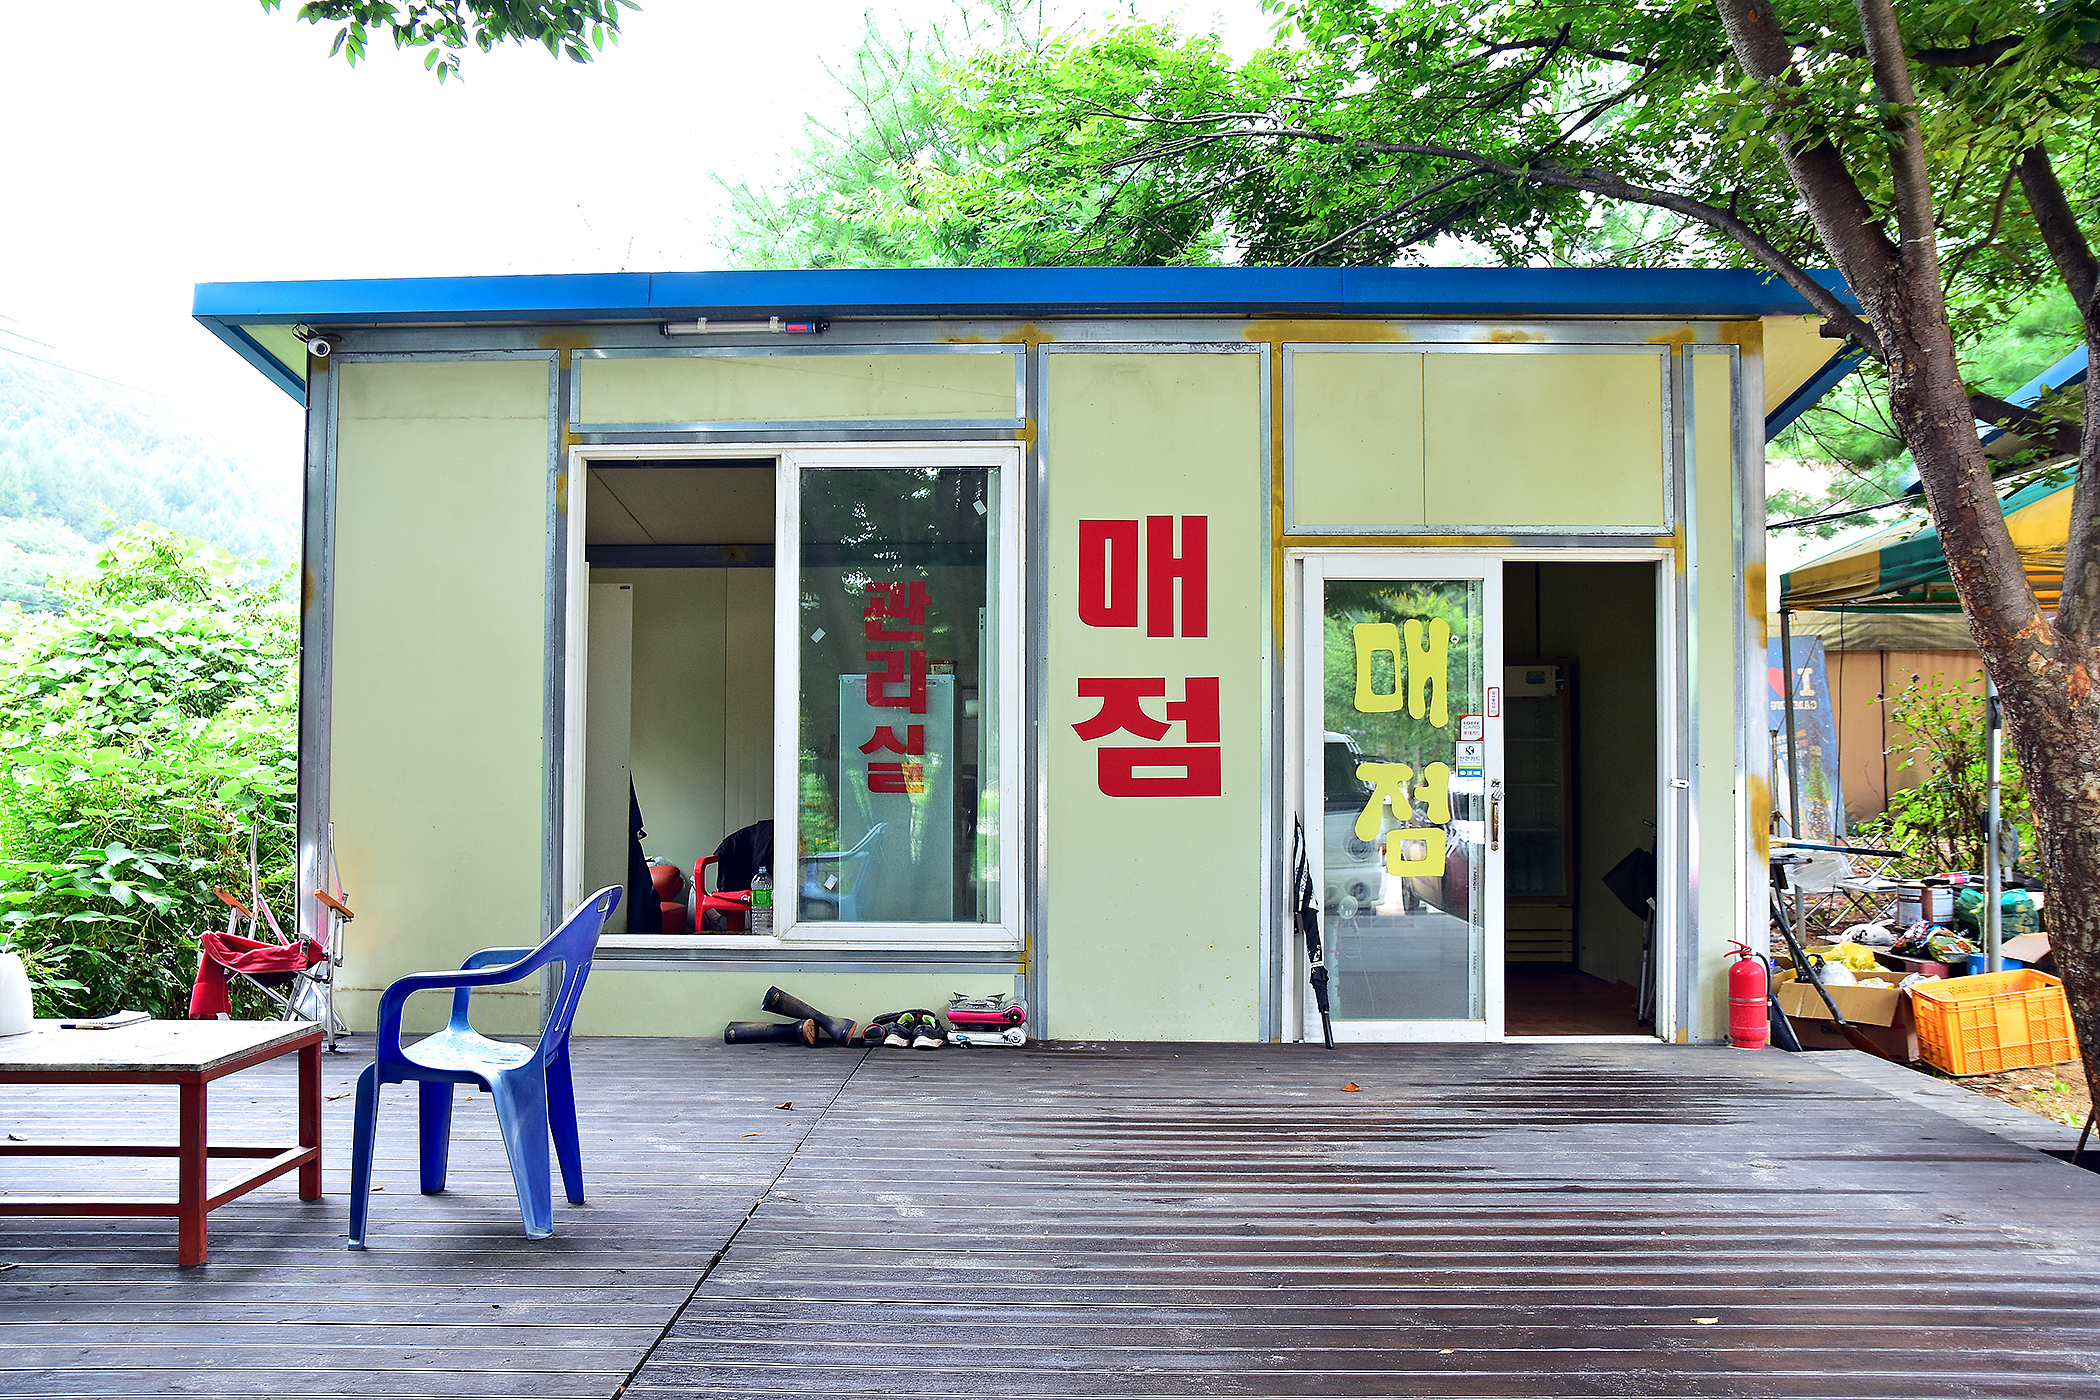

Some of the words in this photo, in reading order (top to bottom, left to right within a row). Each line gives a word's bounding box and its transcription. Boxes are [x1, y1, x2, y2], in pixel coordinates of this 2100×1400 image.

[858, 581, 932, 794] 관리실
[1071, 515, 1222, 798] 매점
[1353, 617, 1450, 877] 매점
